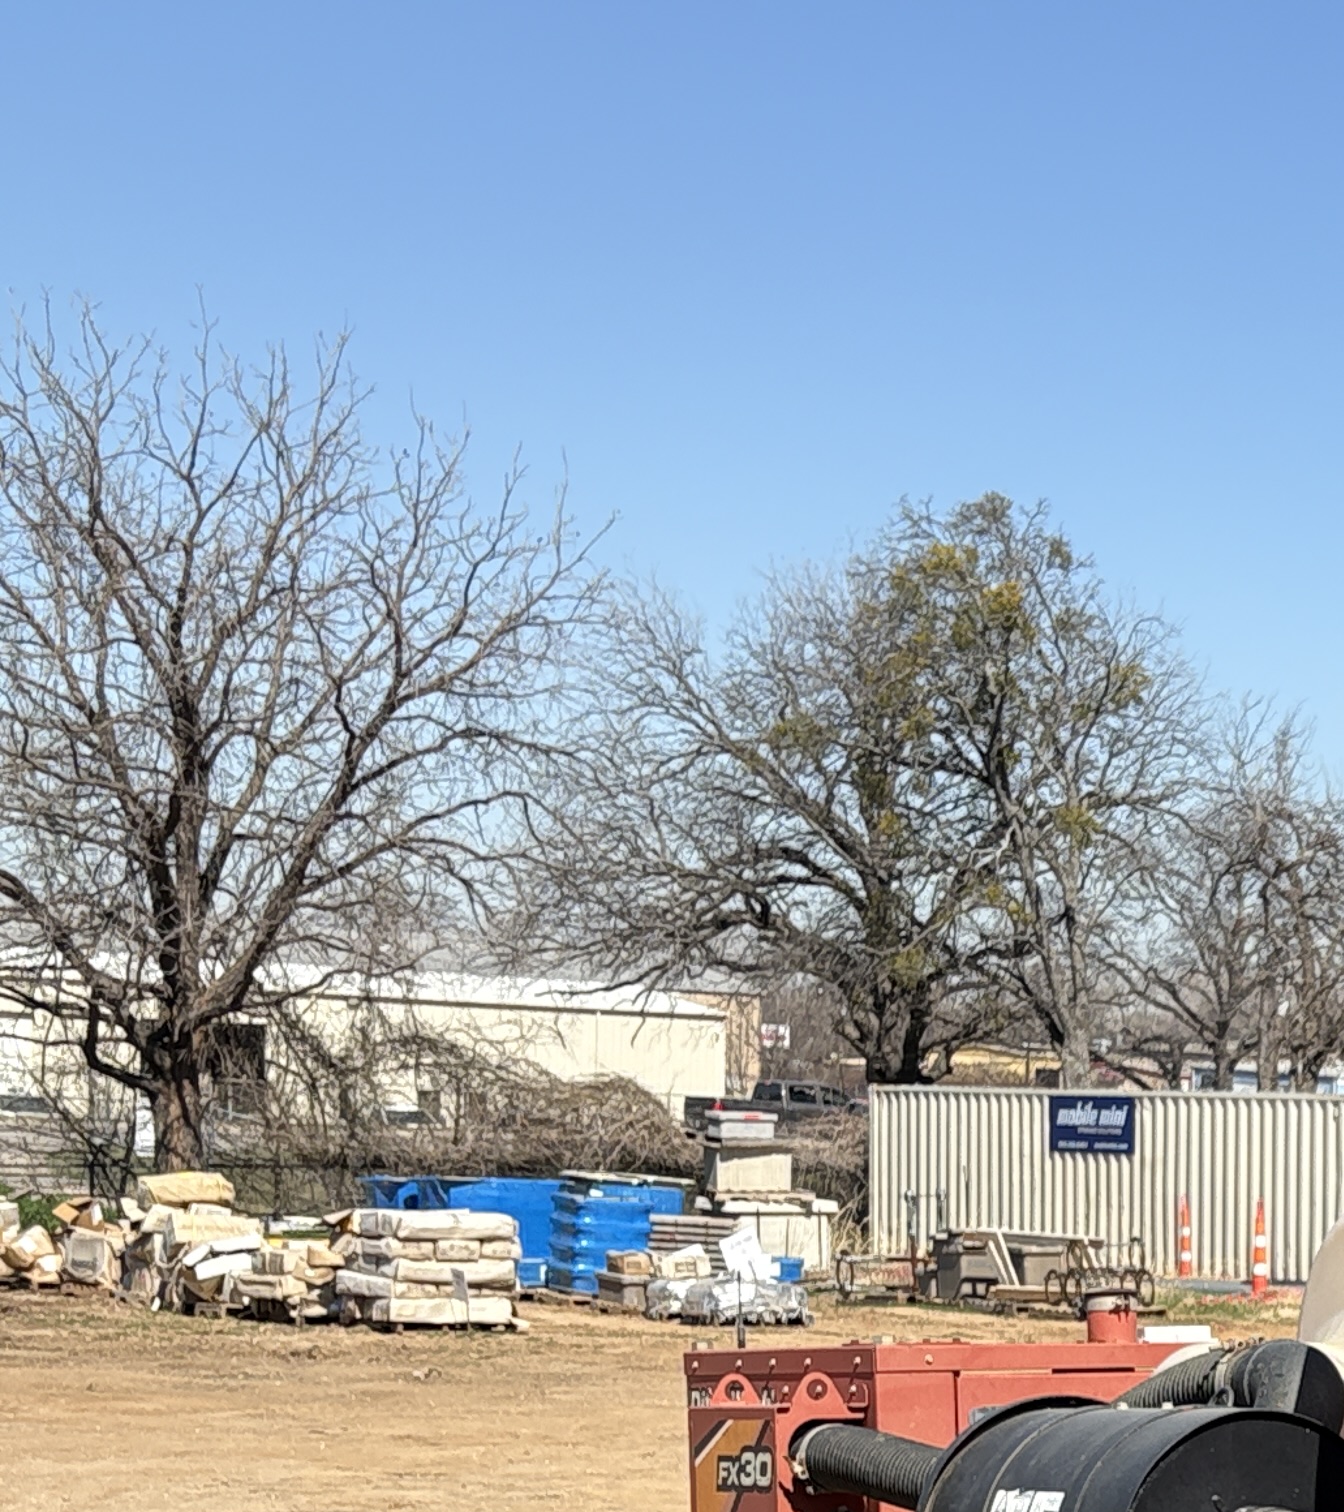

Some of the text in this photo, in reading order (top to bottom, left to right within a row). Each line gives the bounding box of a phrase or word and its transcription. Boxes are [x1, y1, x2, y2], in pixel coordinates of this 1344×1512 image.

[1056, 1100, 1129, 1127] mobile mini
[717, 1451, 772, 1487] FX30
